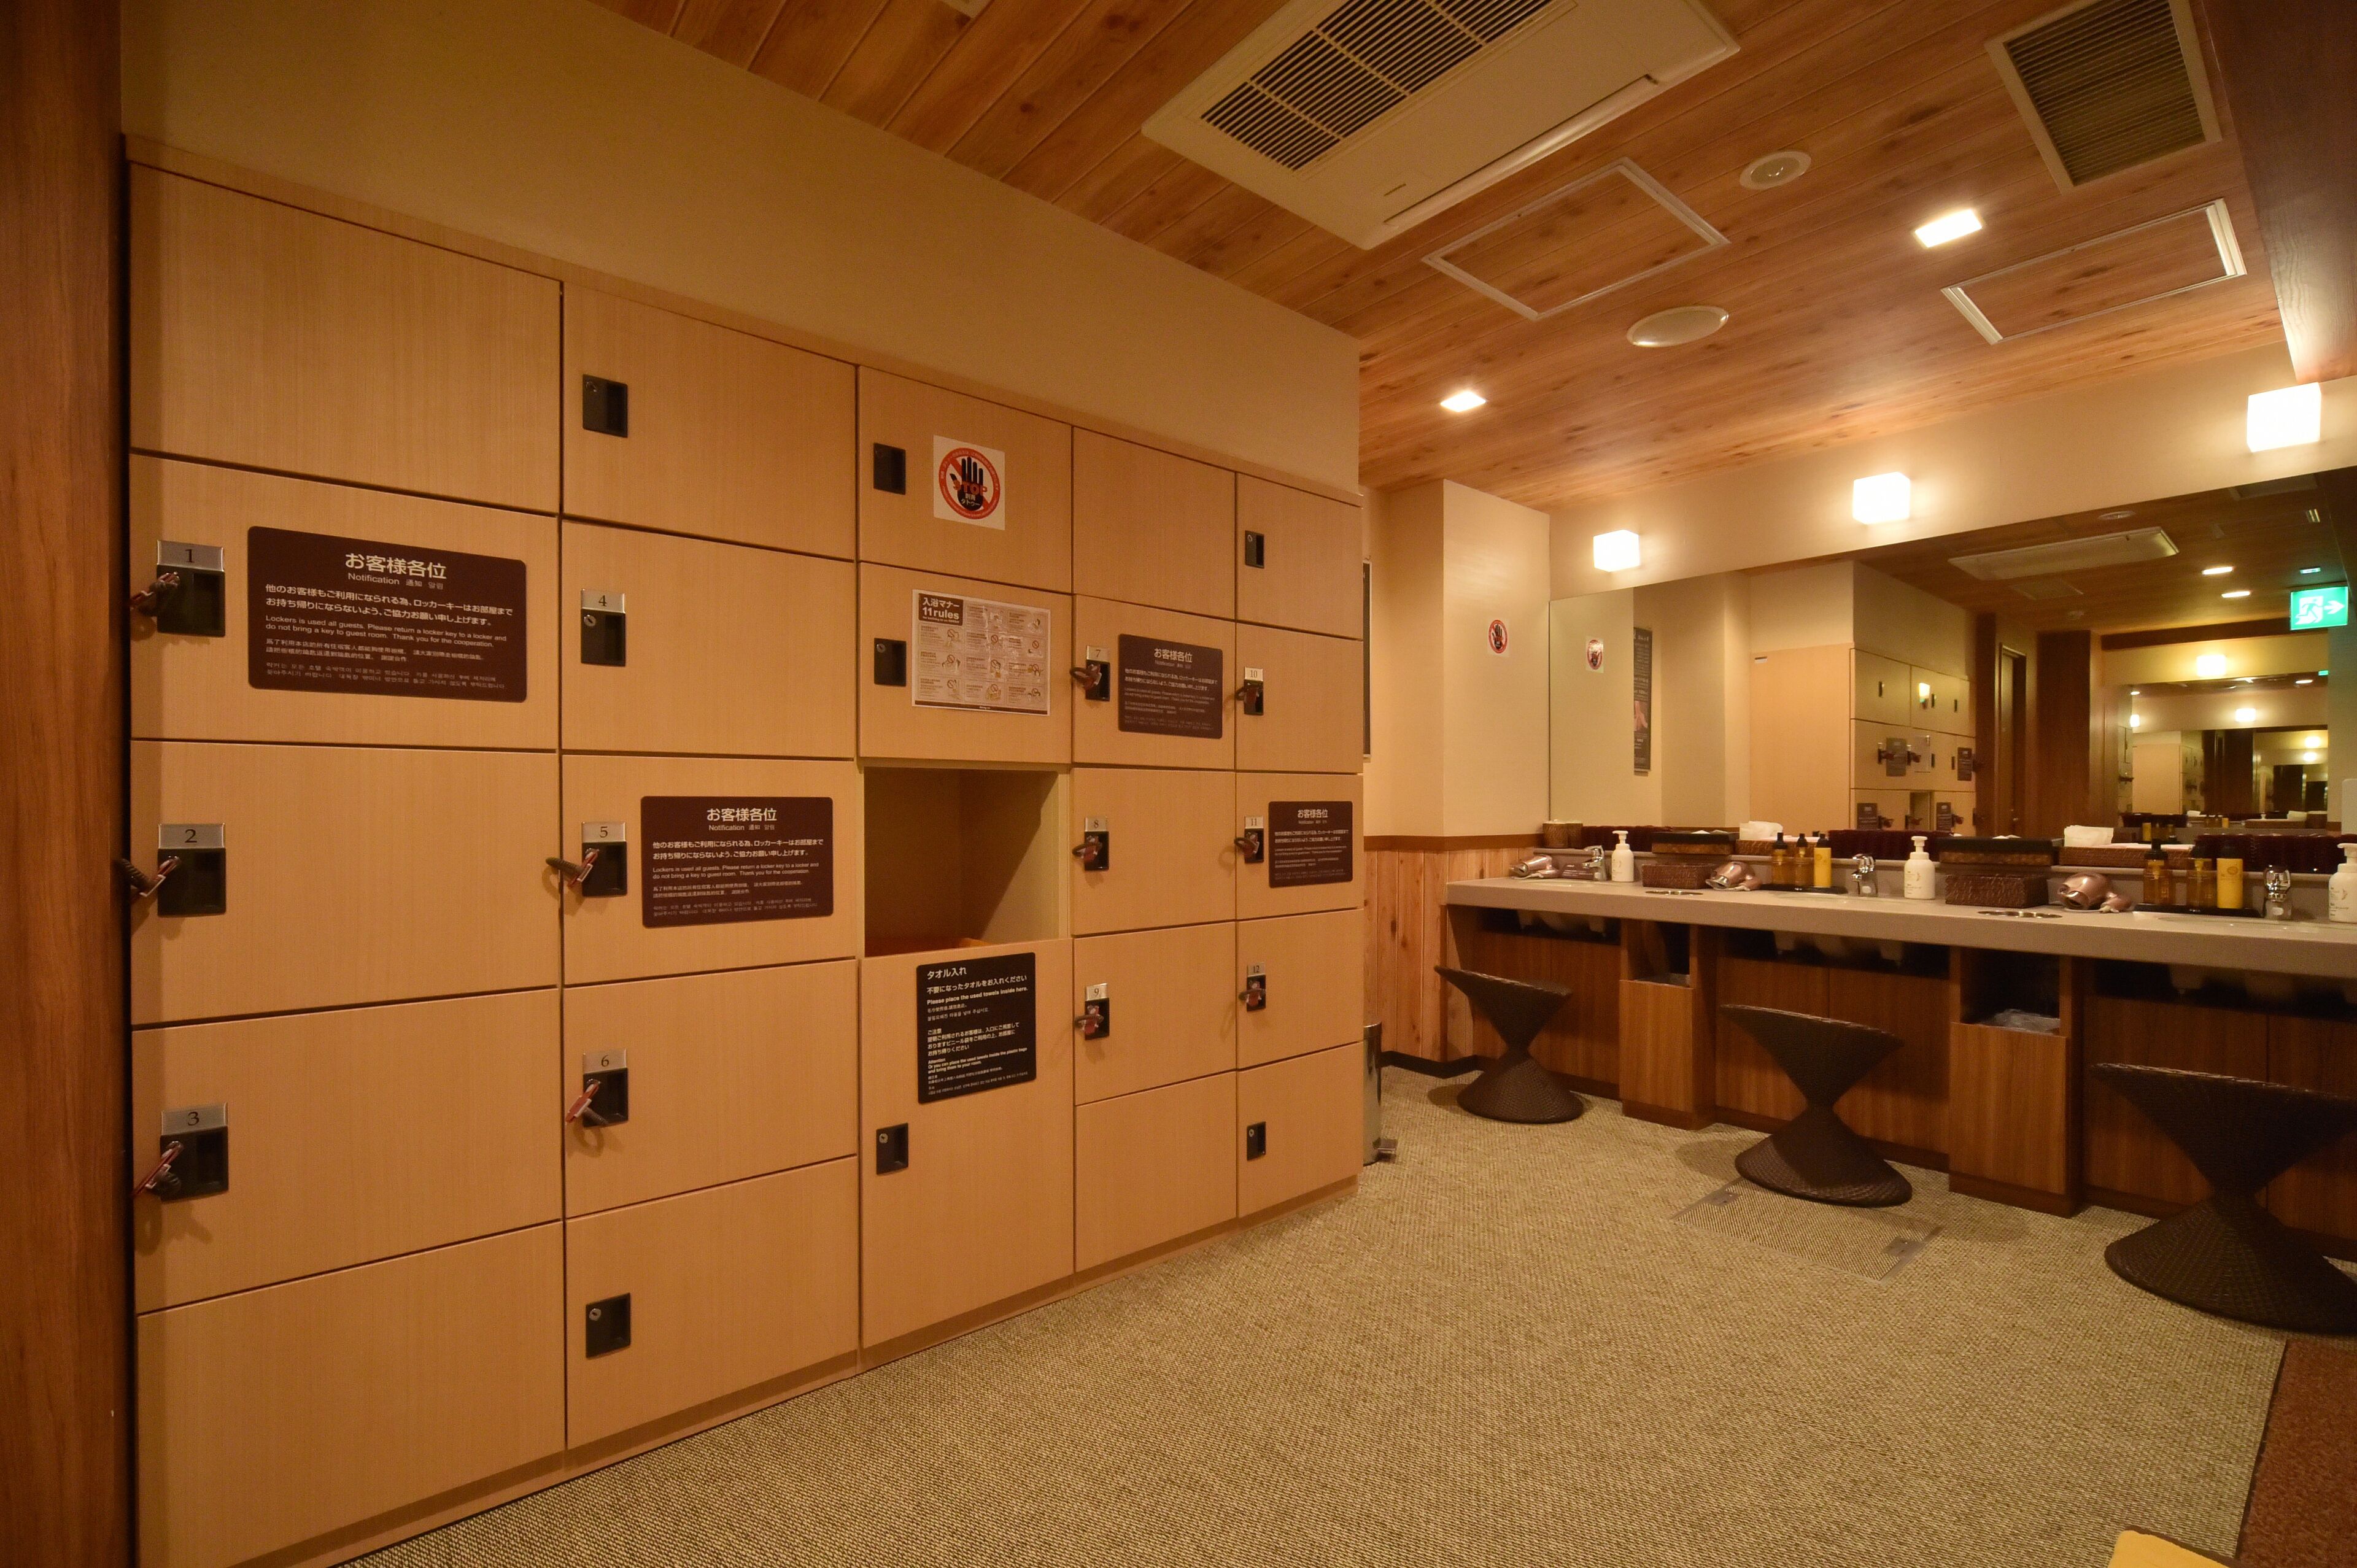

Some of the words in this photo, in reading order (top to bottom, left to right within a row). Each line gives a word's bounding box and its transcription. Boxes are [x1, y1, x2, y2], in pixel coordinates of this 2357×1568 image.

[953, 481, 988, 496] STOP
[185, 549, 195, 563] 1
[345, 553, 446, 579] お客様各位
[347, 572, 399, 584] Notification
[598, 595, 607, 607] 4
[923, 597, 960, 609] 入浴マナー
[292, 625, 312, 633] bring
[1154, 647, 1192, 662] お客様各位
[1250, 670, 1257, 678] 10
[706, 808, 776, 821] お客様各位
[1297, 809, 1328, 818] お客様各位
[185, 829, 198, 843] 2
[600, 826, 608, 838] 5
[927, 967, 967, 979] タオル入れ
[927, 975, 1026, 994] 不要になったタオルをお入れください
[1094, 987, 1099, 997] 9
[601, 1055, 610, 1067] 6
[188, 1111, 199, 1126] 3
